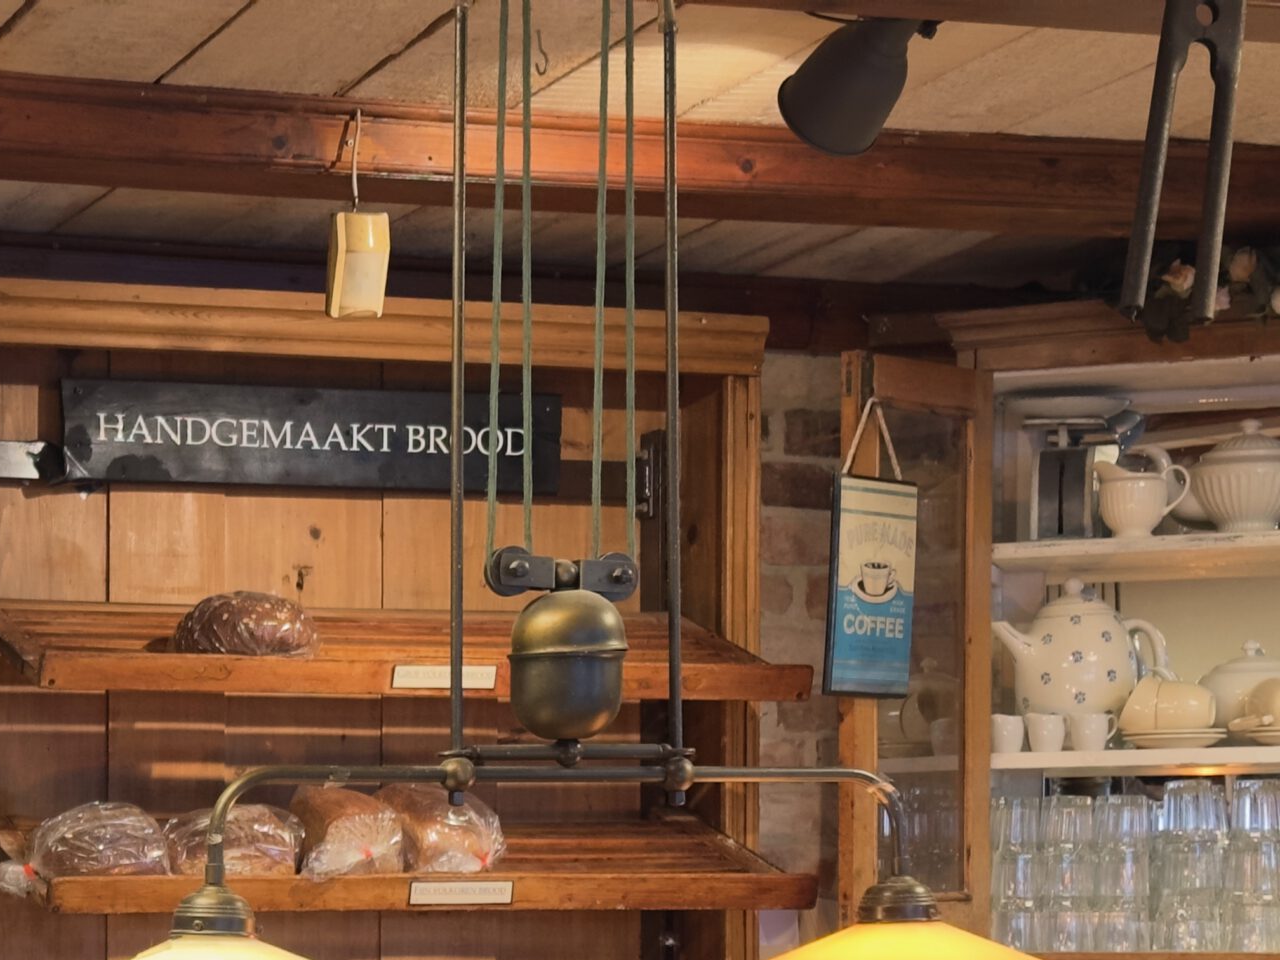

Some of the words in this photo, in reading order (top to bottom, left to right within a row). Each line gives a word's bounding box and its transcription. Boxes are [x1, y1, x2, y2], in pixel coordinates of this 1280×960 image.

[96, 412, 396, 453] HANDGEMAAKT
[406, 424, 526, 456] BROOD
[843, 614, 905, 639] COFFEE
